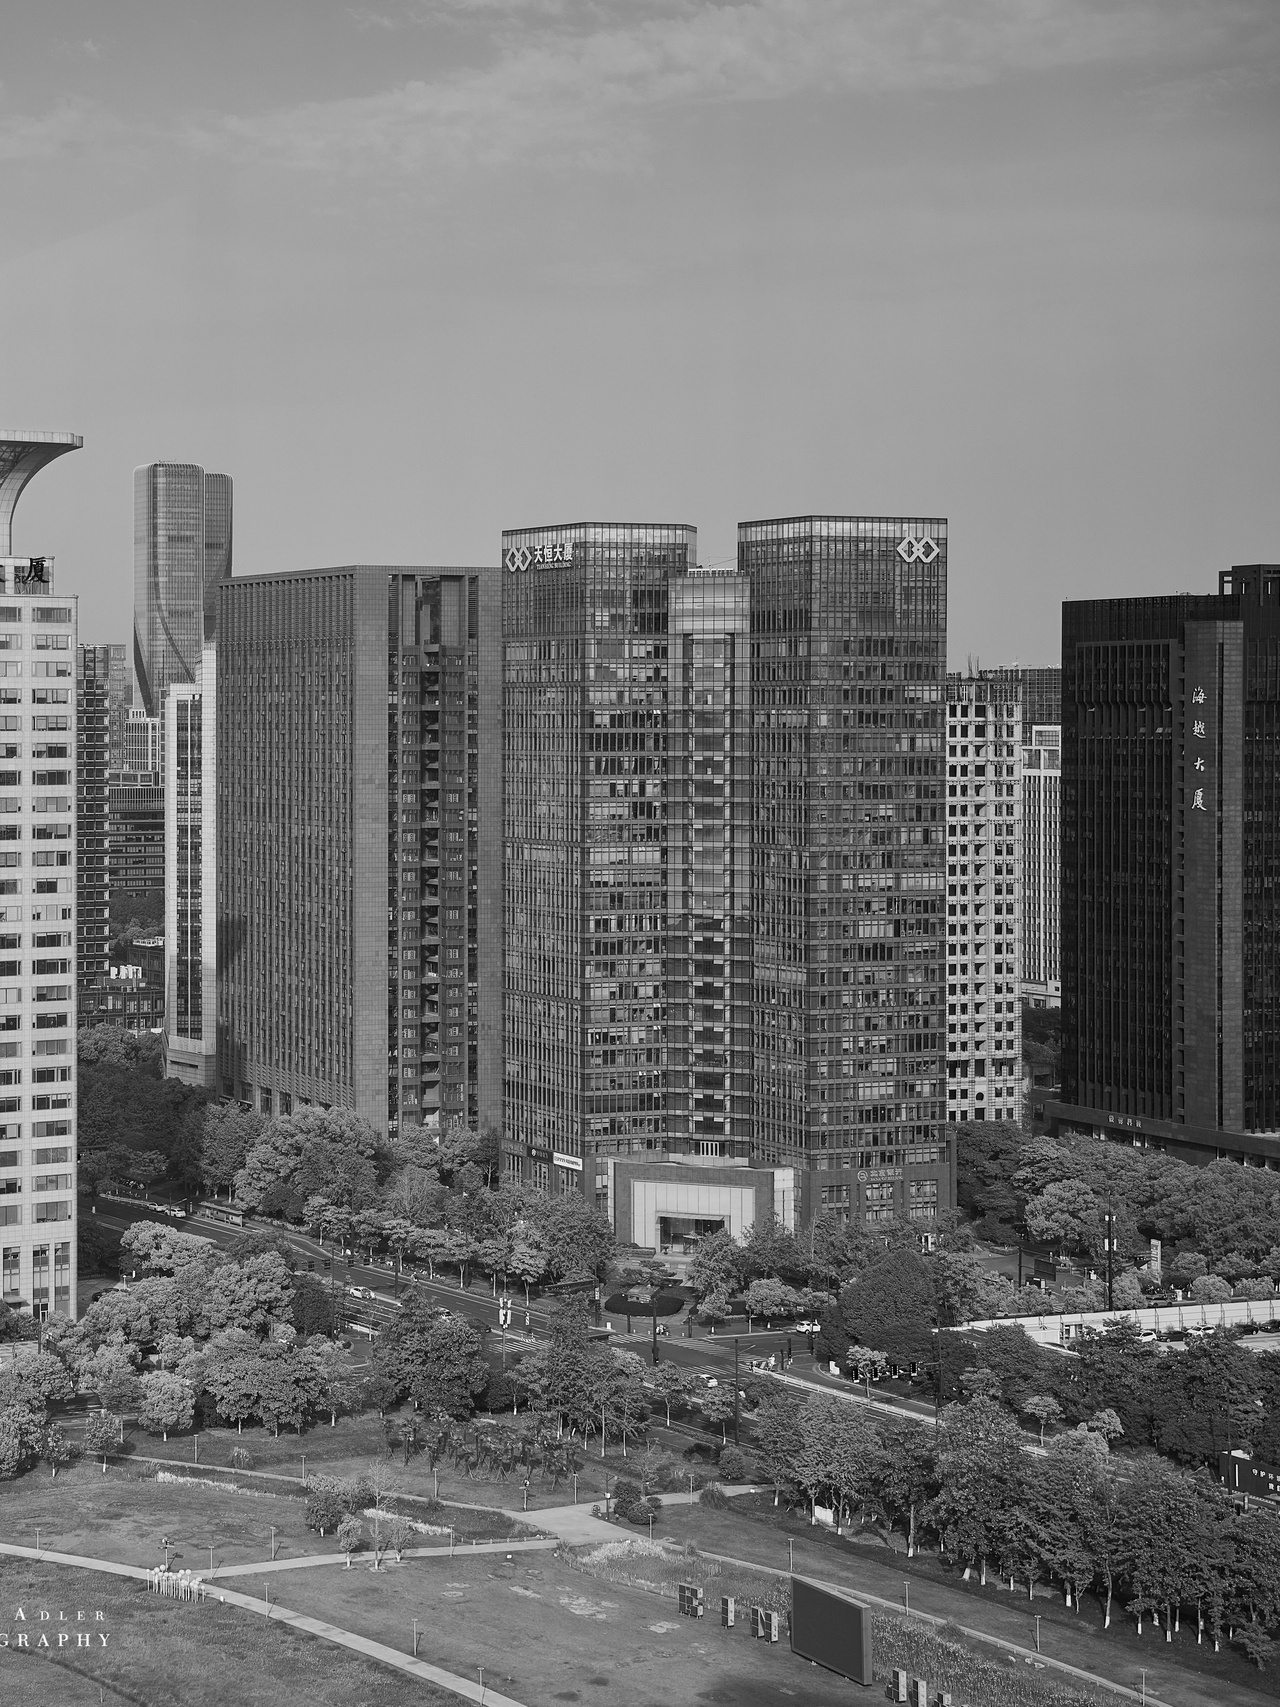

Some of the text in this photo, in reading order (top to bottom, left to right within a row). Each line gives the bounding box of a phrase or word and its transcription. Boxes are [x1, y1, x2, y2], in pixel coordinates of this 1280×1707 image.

[534, 543, 573, 563] 天恒大厦
[1191, 686, 1208, 811] 海越大厦
